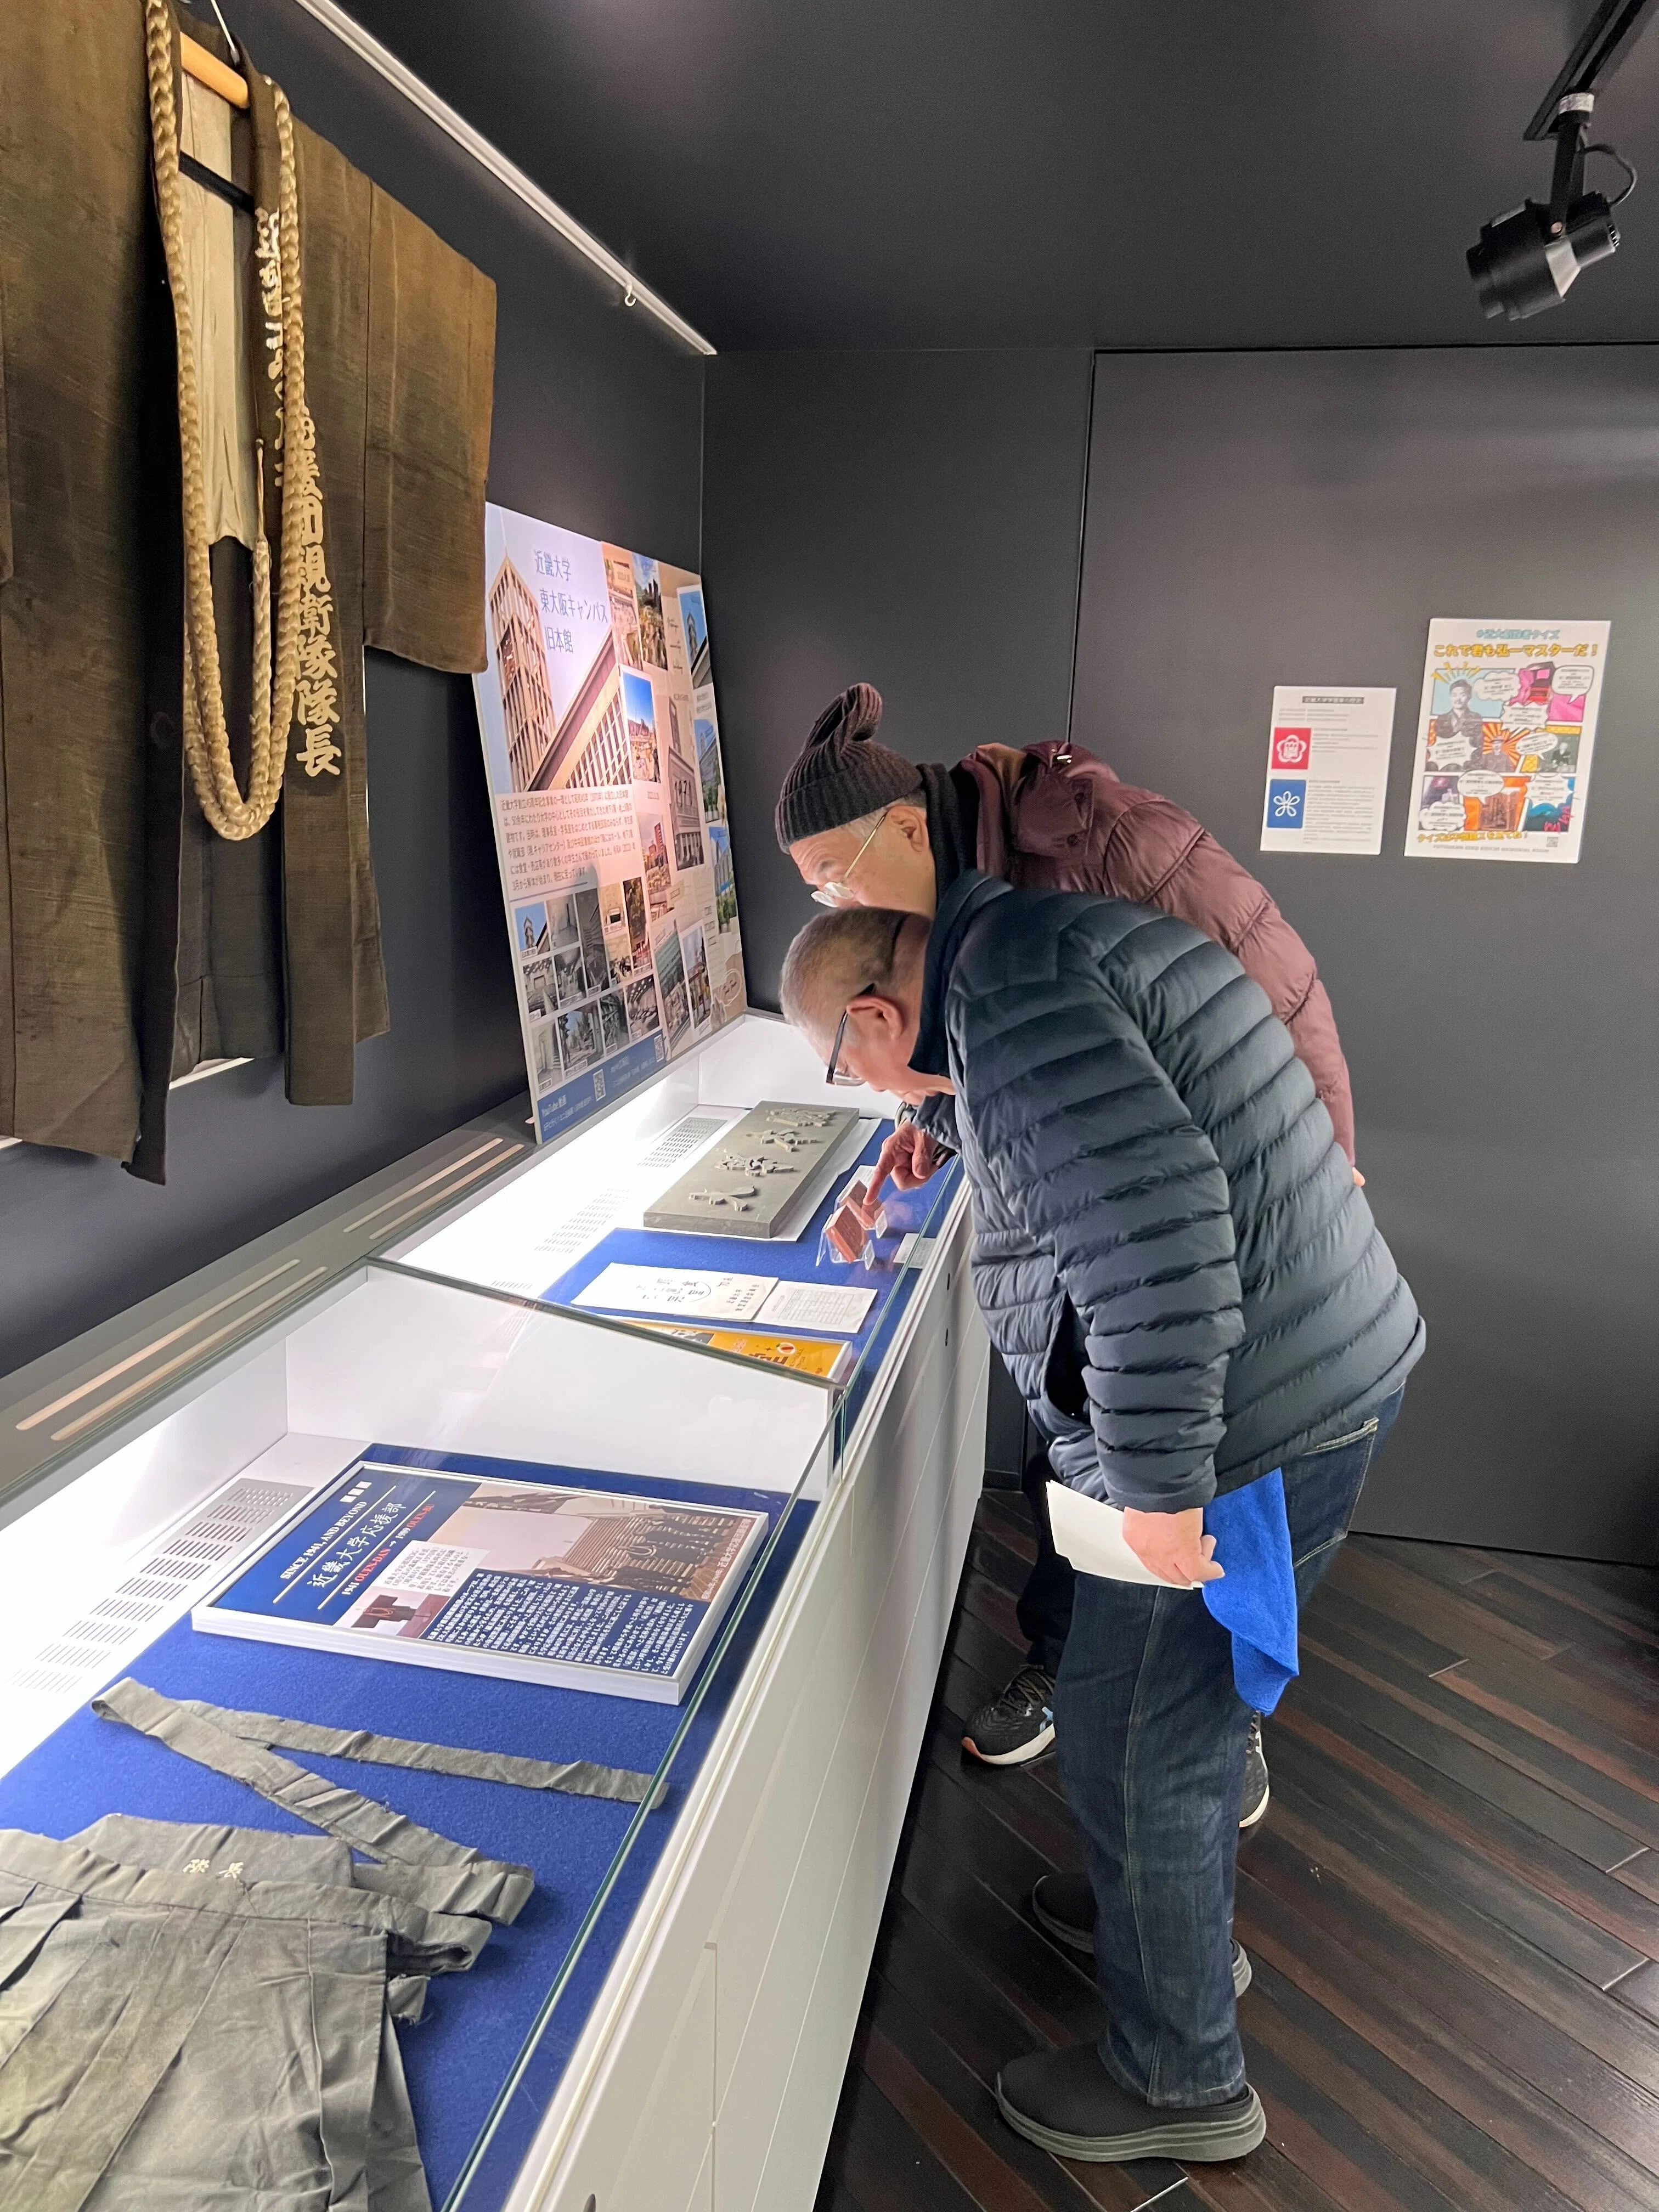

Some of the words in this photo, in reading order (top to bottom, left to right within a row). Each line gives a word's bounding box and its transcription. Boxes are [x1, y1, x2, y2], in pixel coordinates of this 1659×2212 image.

[534, 549, 571, 582] 近畿大学
[539, 588, 608, 624] 東大阪キャンパス
[545, 625, 573, 653] 旧本館
[1434, 643, 1599, 658] これで君も弘一マスターだ！
[278, 1556, 311, 1579] SINCE
[302, 1541, 328, 1556] 1941,
[319, 1526, 342, 1541] AND
[335, 1500, 369, 1527] BEYOND
[303, 1501, 409, 1588] 近畿大学応援部
[340, 1581, 362, 1595] 1941
[353, 1548, 392, 1582] OUEN-DAN
[592, 1644, 611, 1664] あります。
